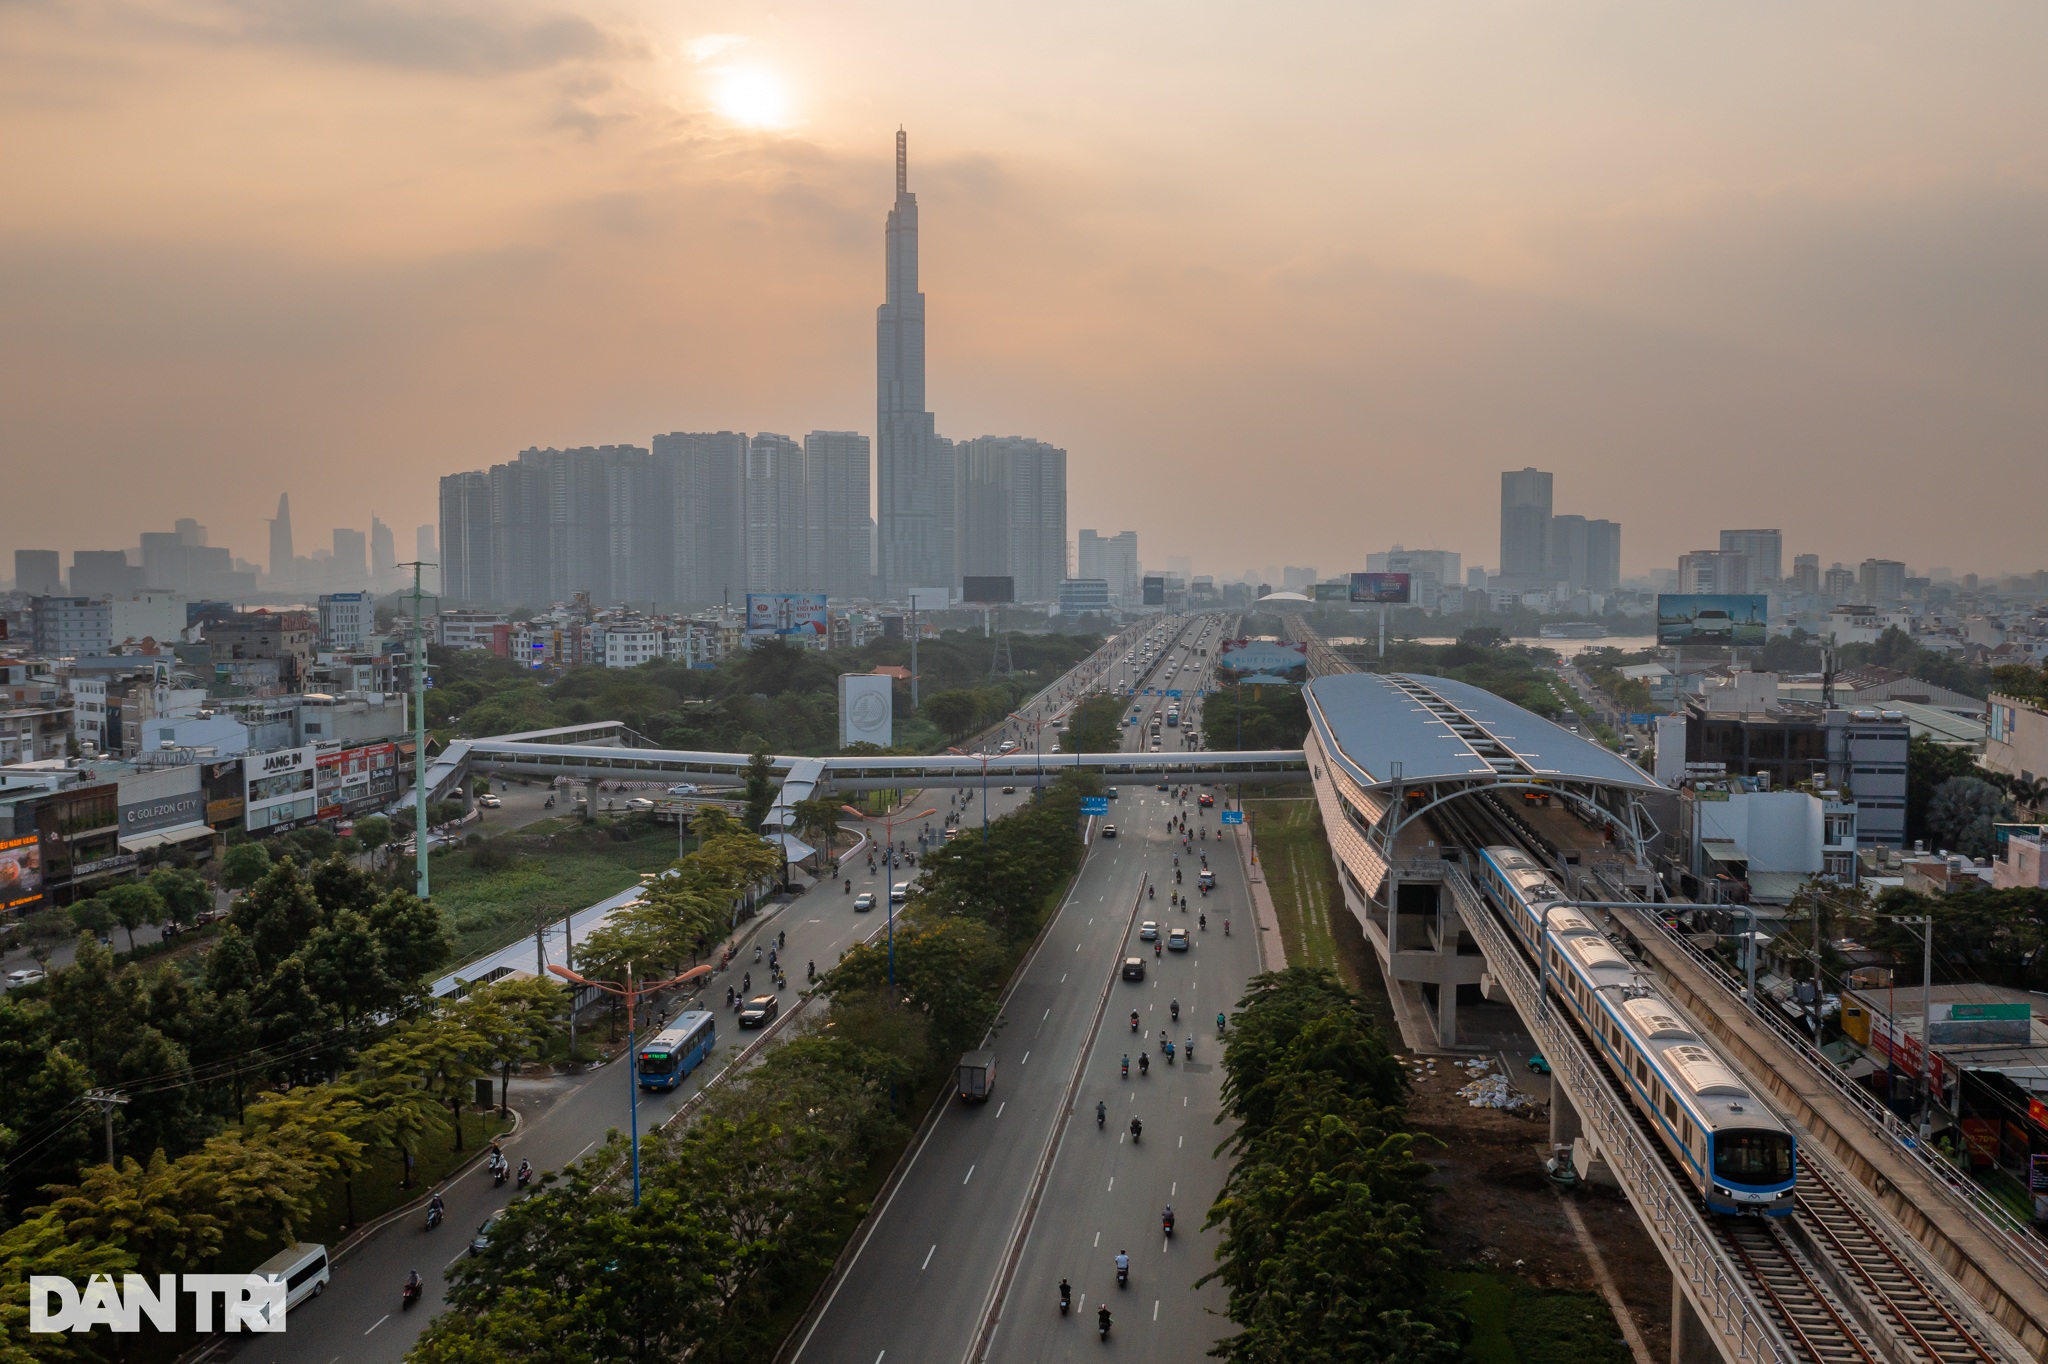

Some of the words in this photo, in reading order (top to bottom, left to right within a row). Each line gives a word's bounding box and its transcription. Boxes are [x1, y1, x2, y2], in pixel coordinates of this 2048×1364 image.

[263, 755, 289, 770] JANG
[292, 752, 302, 765] IN
[137, 804, 176, 819] GOLFZON
[176, 800, 197, 812] CITY
[274, 822, 288, 834] JANG
